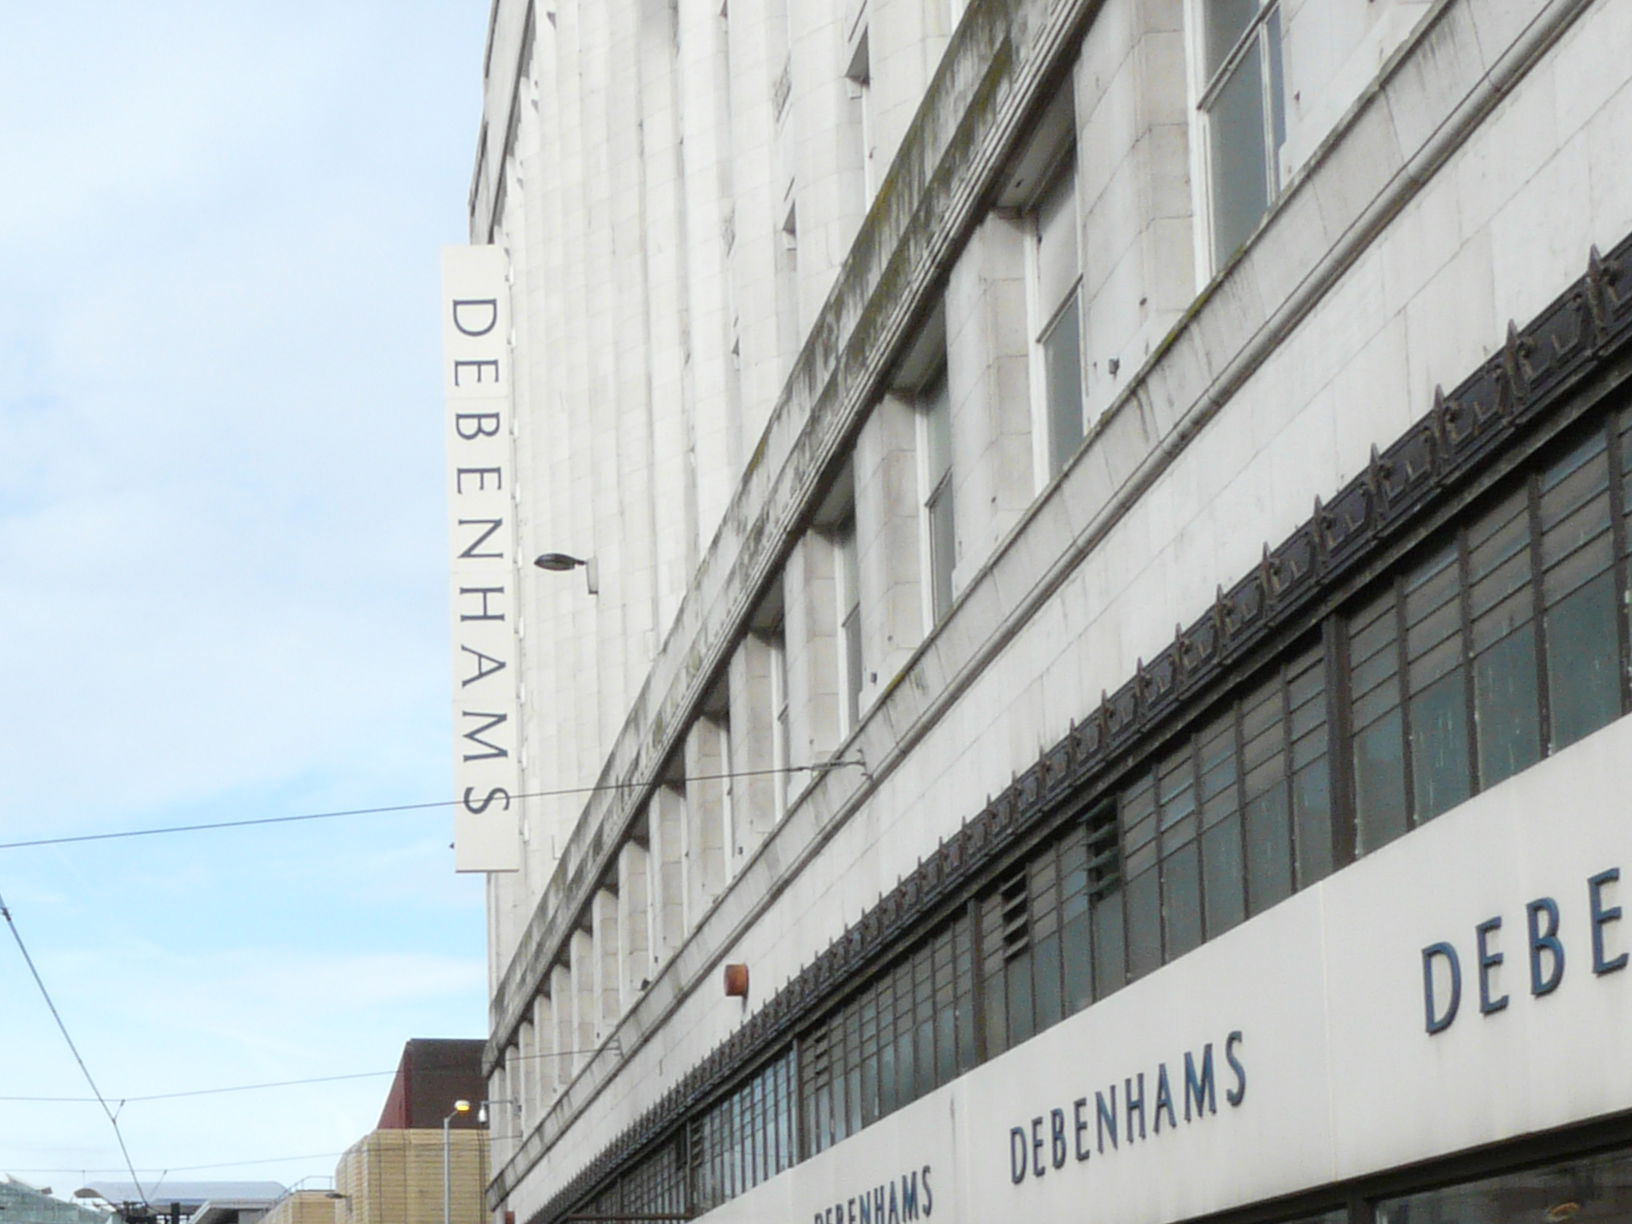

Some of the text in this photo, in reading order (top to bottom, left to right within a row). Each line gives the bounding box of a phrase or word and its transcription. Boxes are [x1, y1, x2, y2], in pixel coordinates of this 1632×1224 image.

[452, 298, 510, 815] DEBENHAMS
[1421, 866, 1631, 1037] DEBE
[1010, 1030, 1247, 1186] DEBENHAMS
